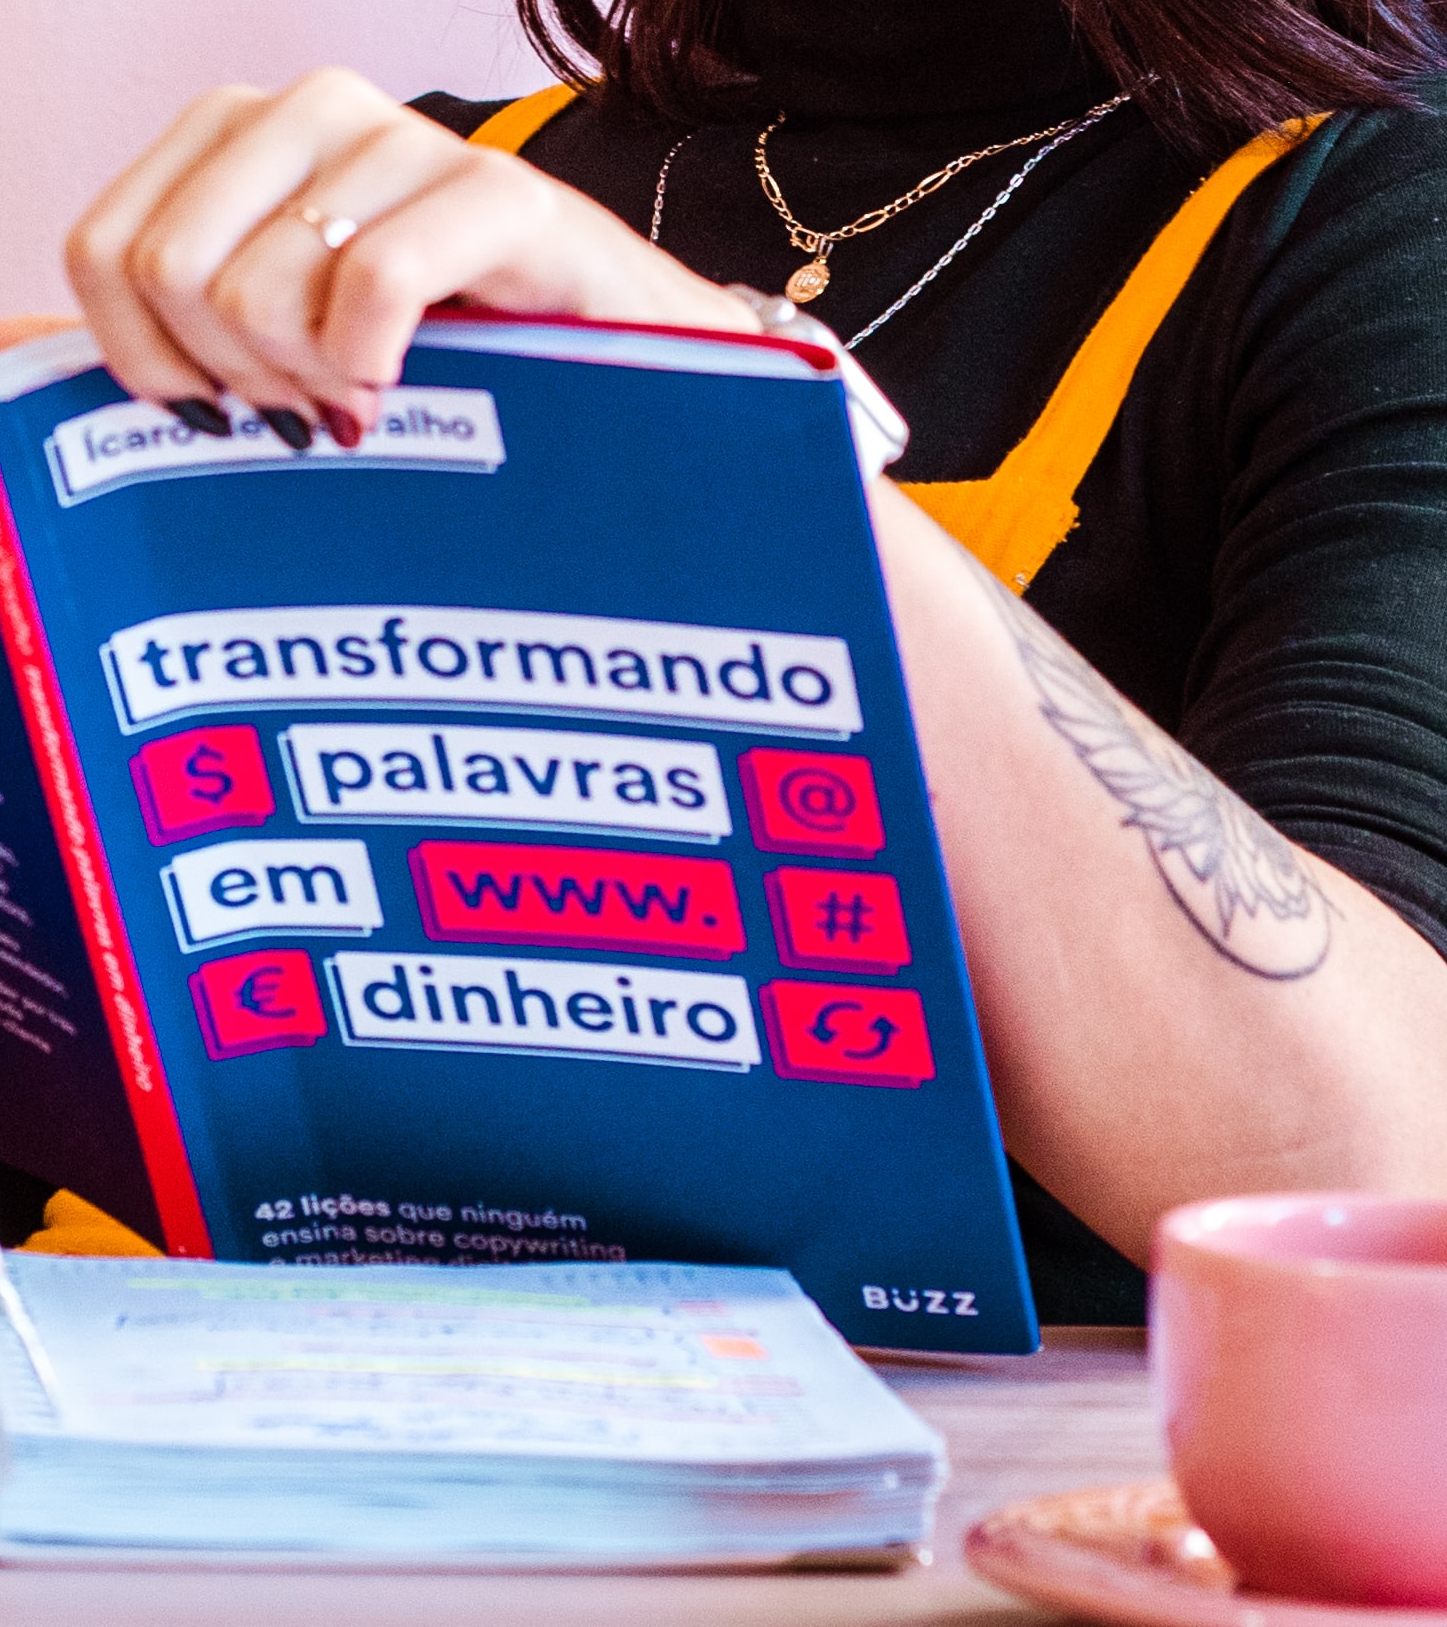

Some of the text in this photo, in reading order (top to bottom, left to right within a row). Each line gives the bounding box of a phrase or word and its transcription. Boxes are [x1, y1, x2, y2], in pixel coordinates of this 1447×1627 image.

[138, 617, 835, 709] transformando
[185, 735, 857, 832] $ palavras @
[210, 863, 875, 943] em www. #
[239, 964, 738, 1044] € dinheiro
[255, 1193, 588, 1231] 42 lições que ninguém
[261, 1221, 358, 1248] ensina
[364, 1223, 446, 1248] sobre
[454, 1230, 628, 1263] copywriting
